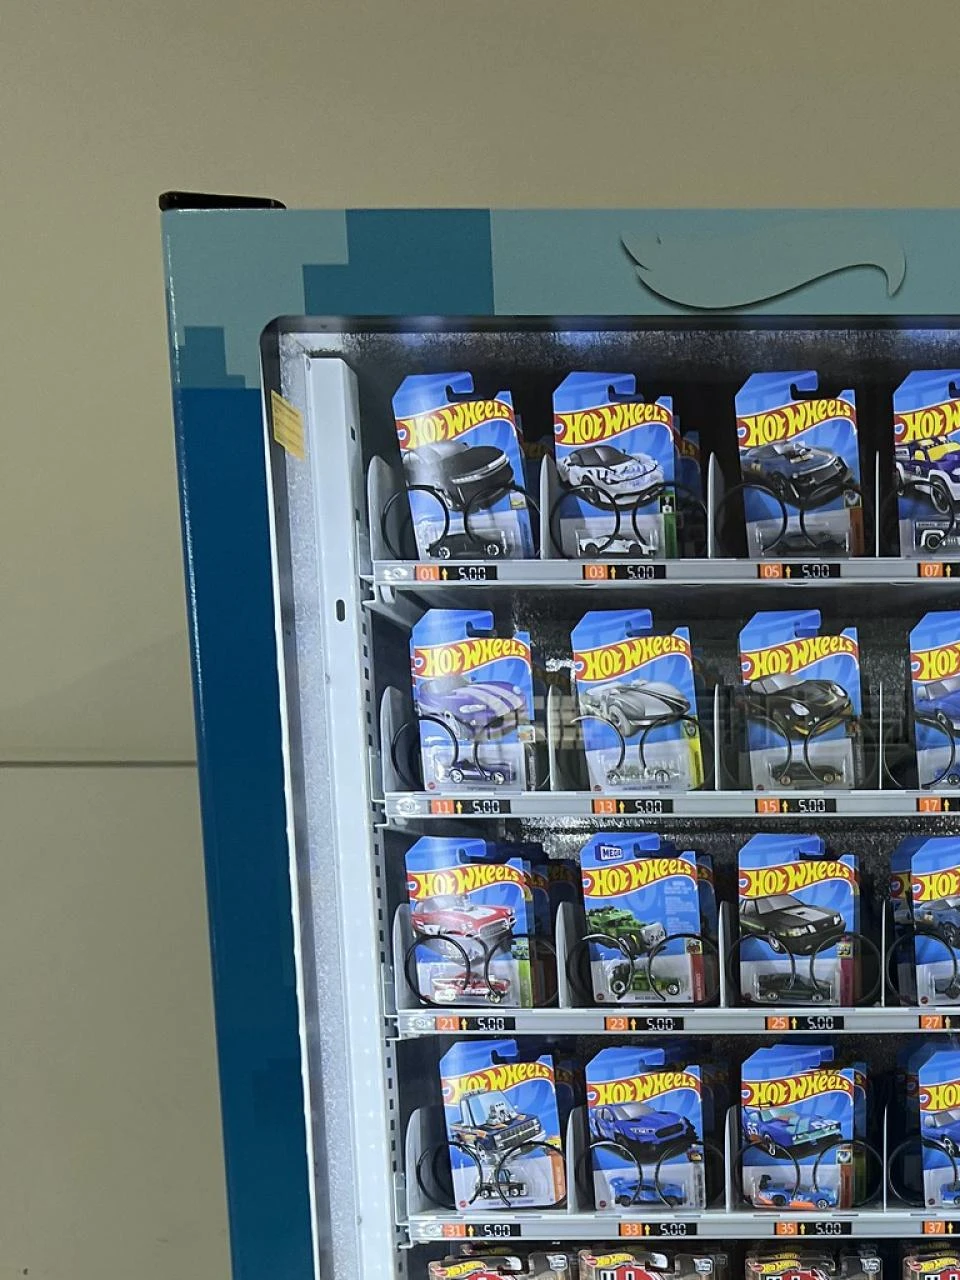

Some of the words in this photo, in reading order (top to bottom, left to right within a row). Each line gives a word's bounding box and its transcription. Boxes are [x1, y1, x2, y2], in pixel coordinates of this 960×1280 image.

[420, 568, 436, 580] 01
[589, 567, 604, 578] 03
[764, 565, 779, 578] 05
[924, 565, 939, 577] 07
[437, 802, 450, 813] 11
[599, 802, 613, 813] 13
[763, 801, 777, 812] 15
[923, 799, 937, 811] 17
[441, 1018, 454, 1030] 21
[610, 1018, 625, 1030] 23
[771, 1017, 786, 1029] 25
[924, 1017, 939, 1028] 27
[446, 1225, 462, 1235] 31
[625, 1225, 639, 1235] 33
[781, 1222, 795, 1234] 35
[928, 1222, 941, 1233] 37
